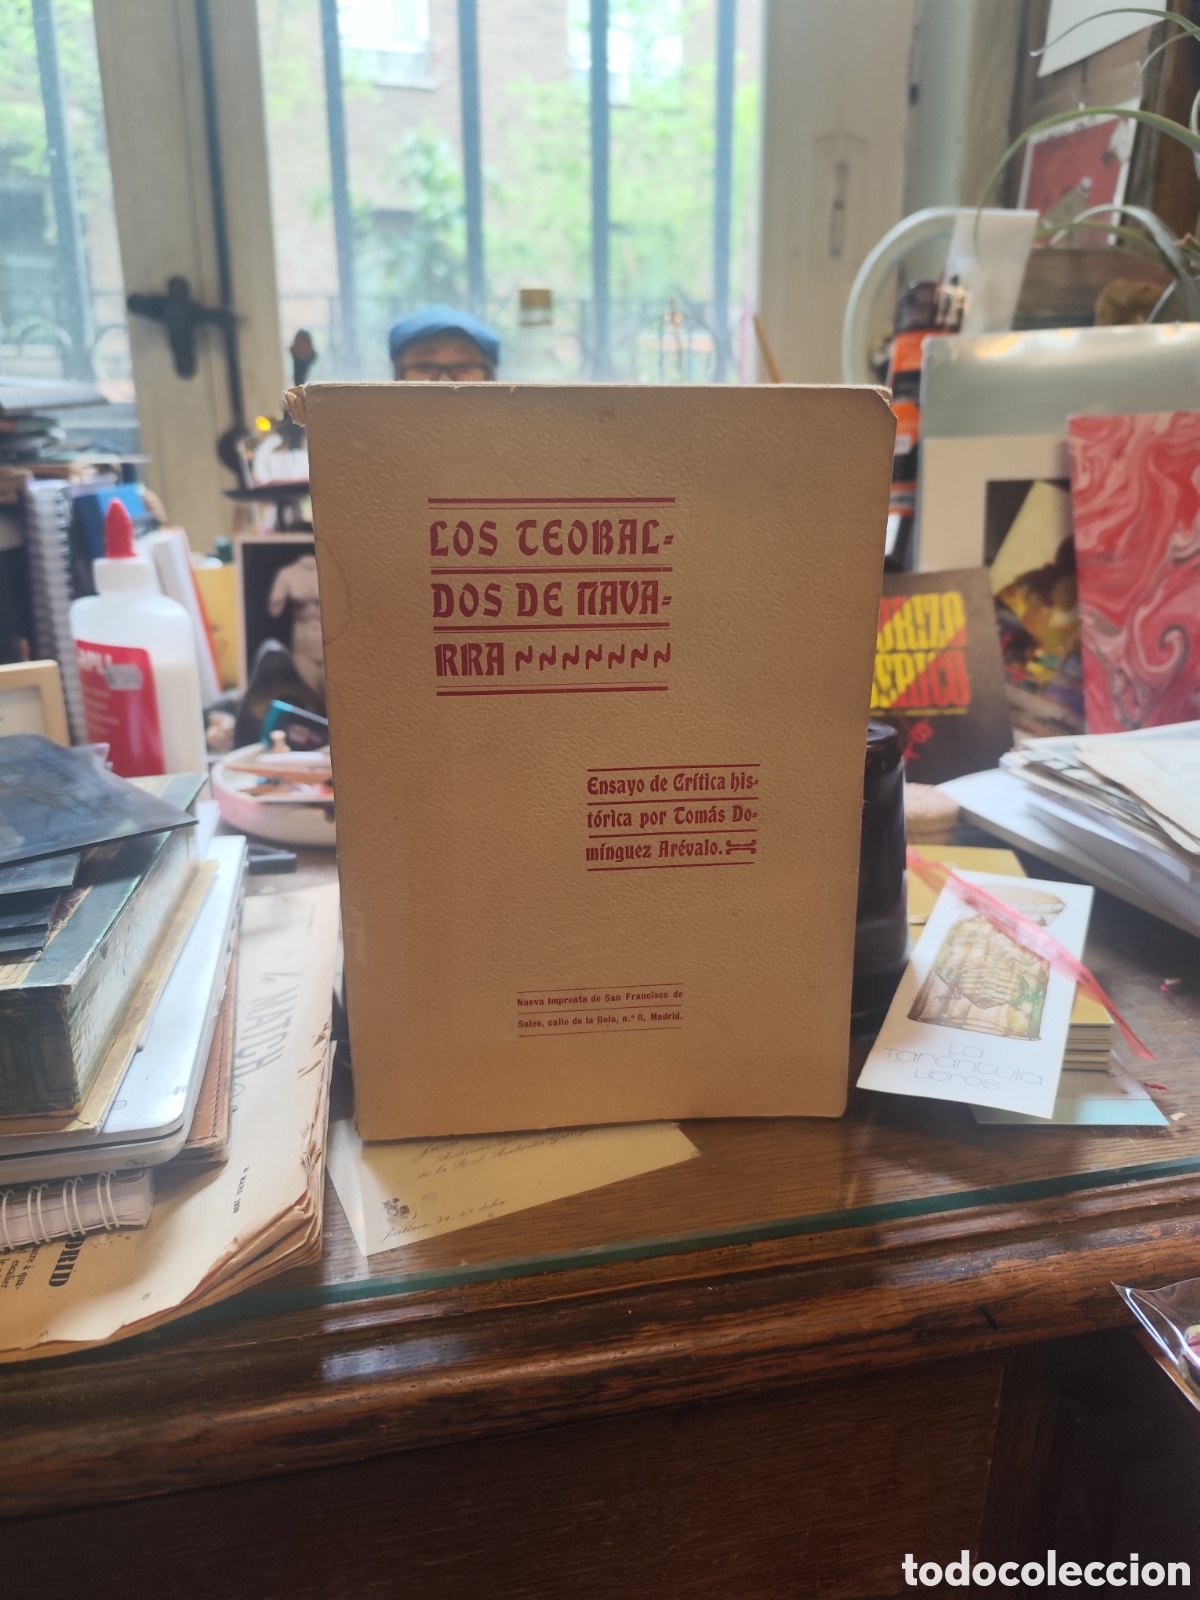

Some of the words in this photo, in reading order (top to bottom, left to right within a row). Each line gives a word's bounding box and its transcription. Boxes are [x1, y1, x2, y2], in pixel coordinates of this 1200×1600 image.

[429, 520, 498, 557] LOS
[430, 582, 503, 618] DOS
[515, 581, 563, 617] DE
[433, 642, 505, 677] RRA
[587, 776, 645, 796] Ensayo
[650, 774, 668, 792] de
[673, 772, 726, 791] Crítica
[587, 809, 632, 828] tórica
[639, 810, 667, 828] por
[673, 805, 726, 825] Tomás
[586, 843, 652, 863] mínguez
[658, 838, 723, 858] Arévalo.
[517, 998, 545, 1007] Nueva
[547, 995, 588, 1006] Imprenta
[590, 994, 601, 1003] de
[604, 993, 621, 1002] San
[625, 991, 669, 1001] Francisco
[673, 990, 683, 998] de
[517, 1019, 545, 1028] Sales,
[547, 1018, 569, 1026] calle
[572, 1017, 583, 1025] de
[585, 1016, 594, 1024] la
[597, 1015, 619, 1024] Bola,
[650, 1011, 683, 1021] Madrid.
[234, 984, 300, 1079] MATCH
[948, 1042, 984, 1058] La
[914, 1068, 1000, 1090] Libros
[435, 1165, 448, 1175] la
